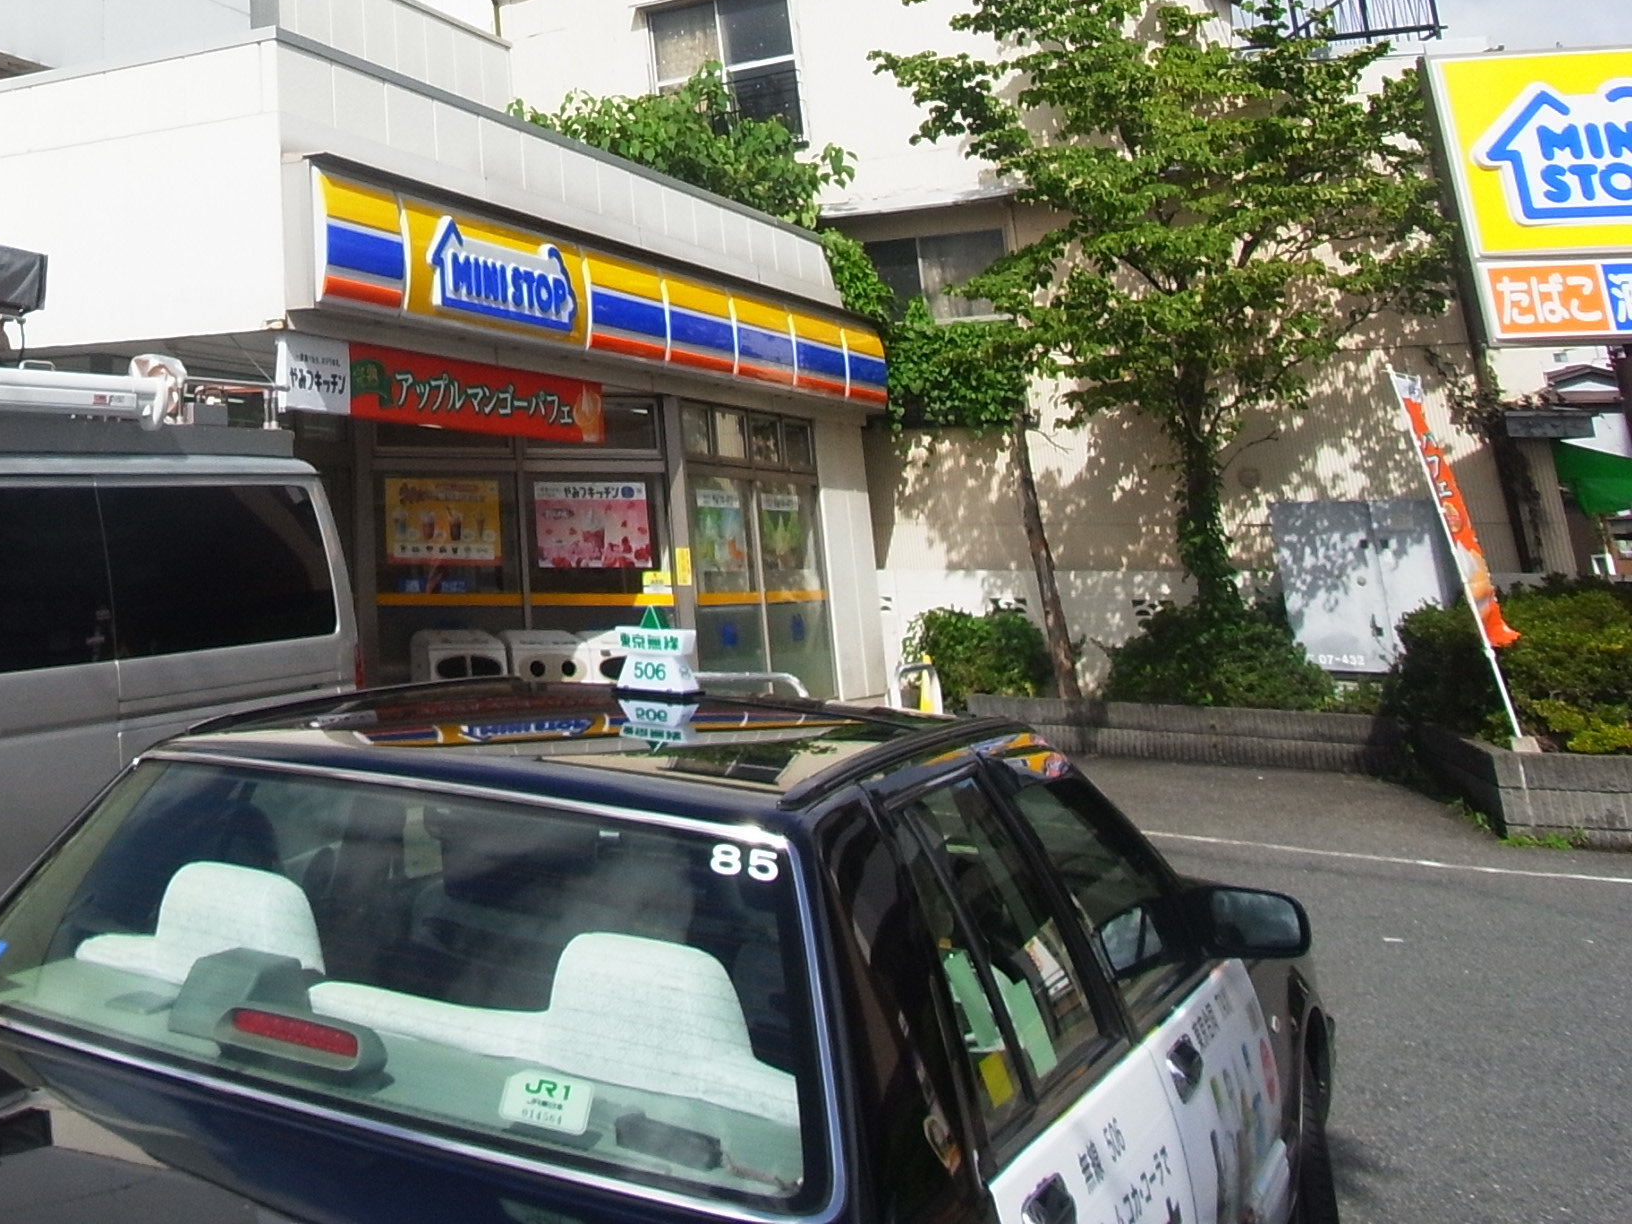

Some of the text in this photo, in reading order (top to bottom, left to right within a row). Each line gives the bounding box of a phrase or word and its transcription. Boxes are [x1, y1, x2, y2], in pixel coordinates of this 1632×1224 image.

[451, 251, 567, 316] MINI STOP
[1496, 273, 1603, 325] たばこ
[395, 373, 572, 424] アップルマンゴーパフェ
[620, 633, 680, 651] 東京無線
[634, 662, 666, 681] 506
[1318, 654, 1365, 666] 07-432
[710, 843, 779, 882] 85
[525, 1079, 571, 1101] JR 1
